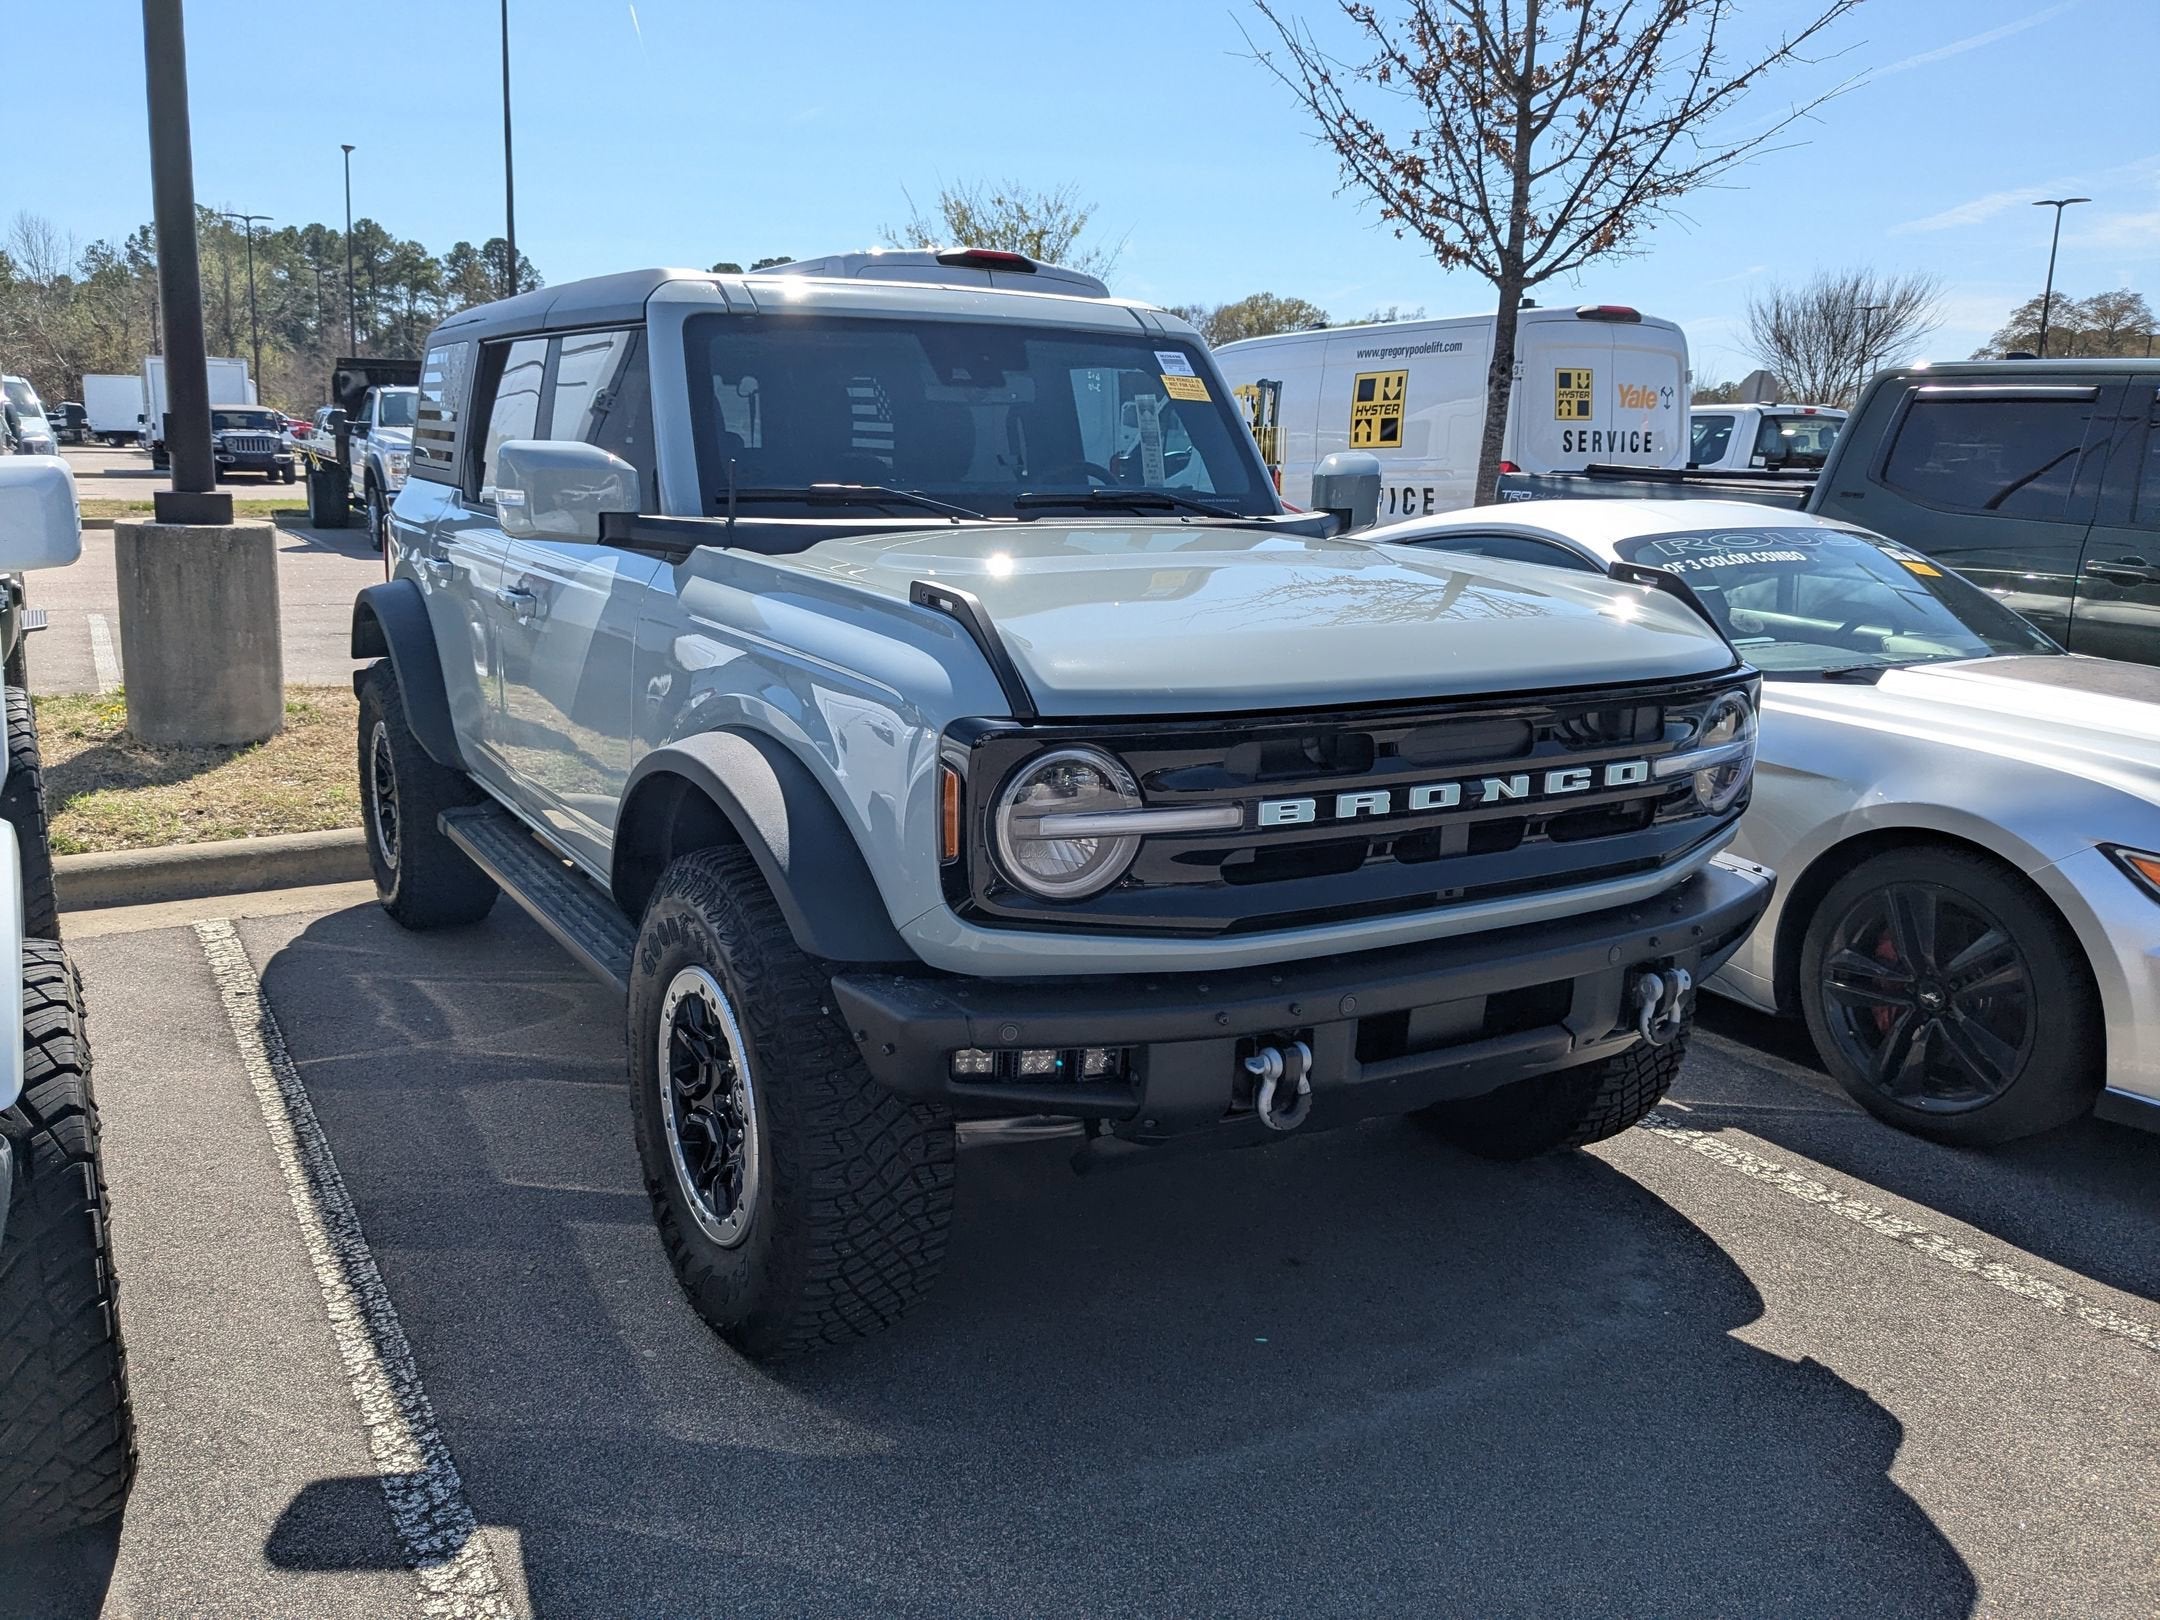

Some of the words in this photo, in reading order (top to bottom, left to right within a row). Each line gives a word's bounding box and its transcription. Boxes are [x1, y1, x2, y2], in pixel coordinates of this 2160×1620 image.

[1356, 340, 1463, 360] www.gregorypoolelift.com
[1558, 390, 1590, 399] HYSTER
[1618, 383, 1658, 410] Yale
[1355, 403, 1401, 417] HYSTER
[1562, 429, 1653, 454] SERVICE
[1380, 487, 1435, 516] ICE
[1501, 490, 1532, 502] TRD
[1685, 559, 1702, 570] 3
[1699, 552, 1753, 568] COLOR
[1750, 550, 1808, 563] COMBO
[1257, 760, 1649, 826] BRONCO
